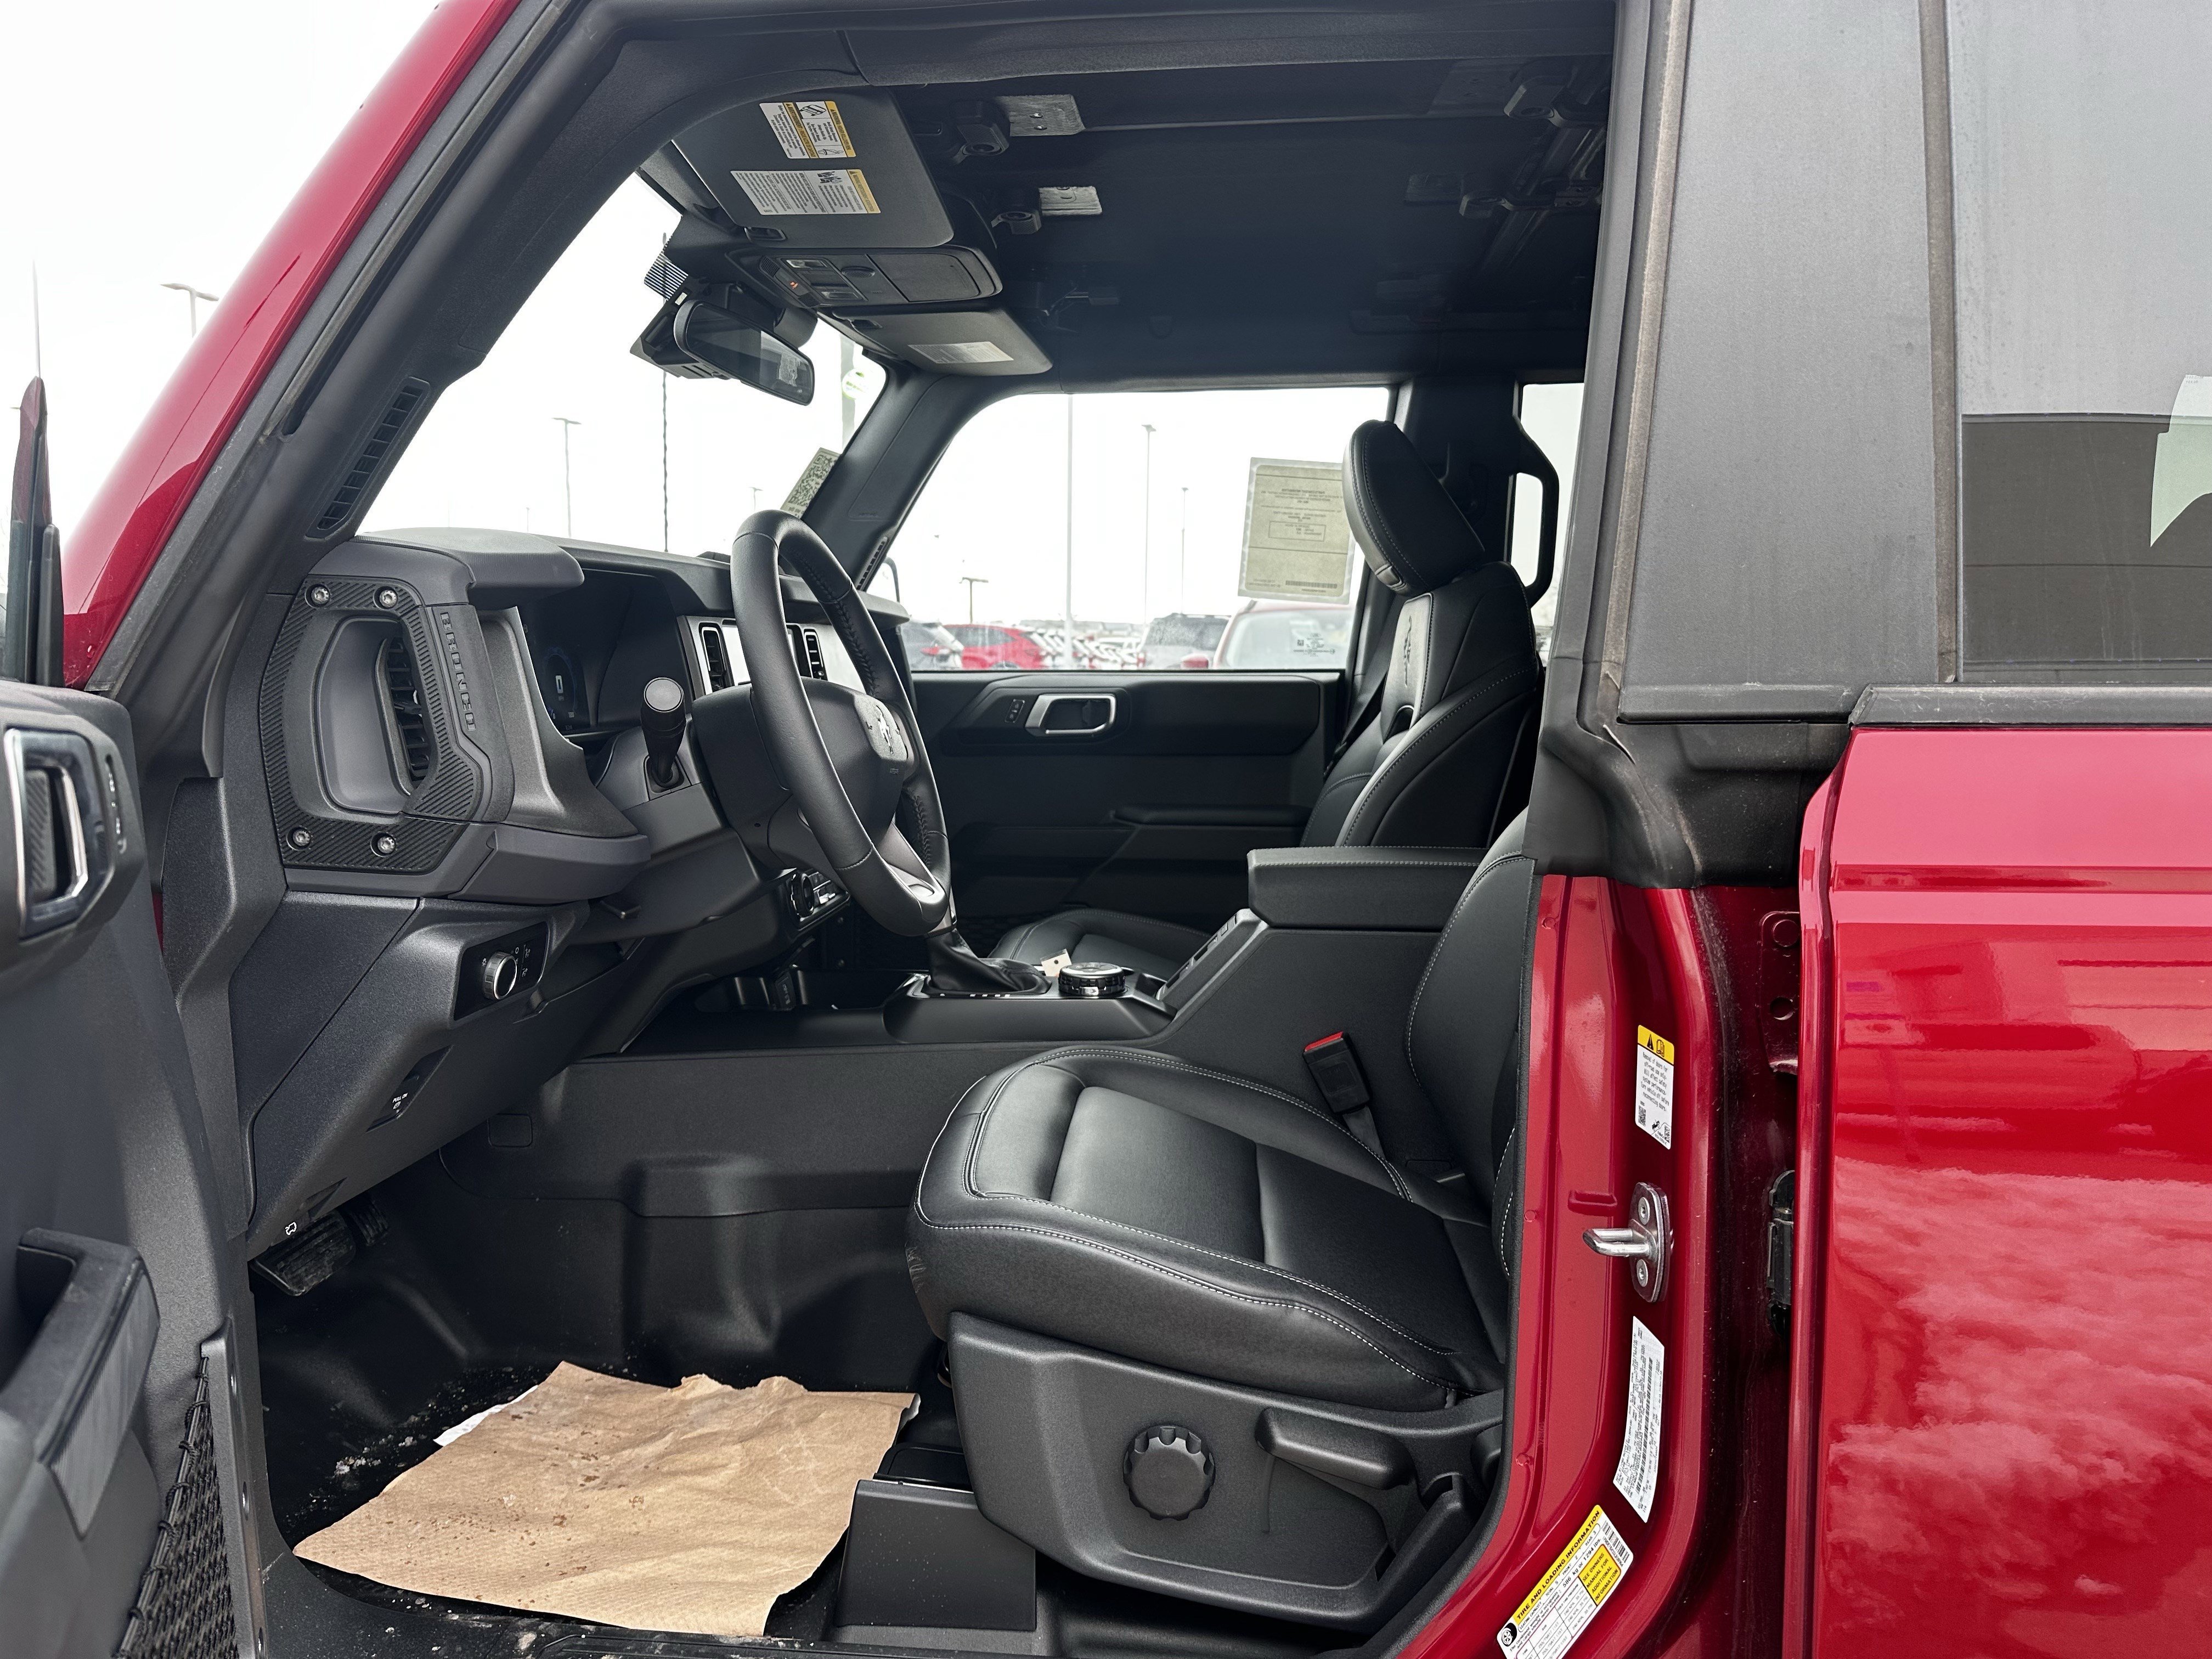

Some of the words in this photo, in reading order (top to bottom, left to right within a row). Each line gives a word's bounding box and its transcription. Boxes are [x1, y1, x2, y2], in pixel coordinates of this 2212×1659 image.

[440, 612, 476, 731] BRONCO
[1584, 1535, 1593, 1546] REAR
[1516, 1602, 1530, 1621] TIRE
[1529, 1588, 1542, 1604] AND
[1541, 1557, 1566, 1589] LOADING
[1565, 1509, 1600, 1559] INFORMATION
[1562, 1576, 1571, 1588] 586
[1571, 1567, 1579, 1577] kg
[1583, 1546, 1594, 1561] 1294
[1582, 1571, 1590, 1582] SEE
[1589, 1551, 1605, 1573] OWNERS
[1586, 1568, 1601, 1589] MANUAL
[1600, 1558, 1609, 1569] FOR
[1590, 1565, 1613, 1594] ADDITIONAL
[1594, 1568, 1618, 1601] INFORMATION
[1519, 1616, 1530, 1630] SEATING
